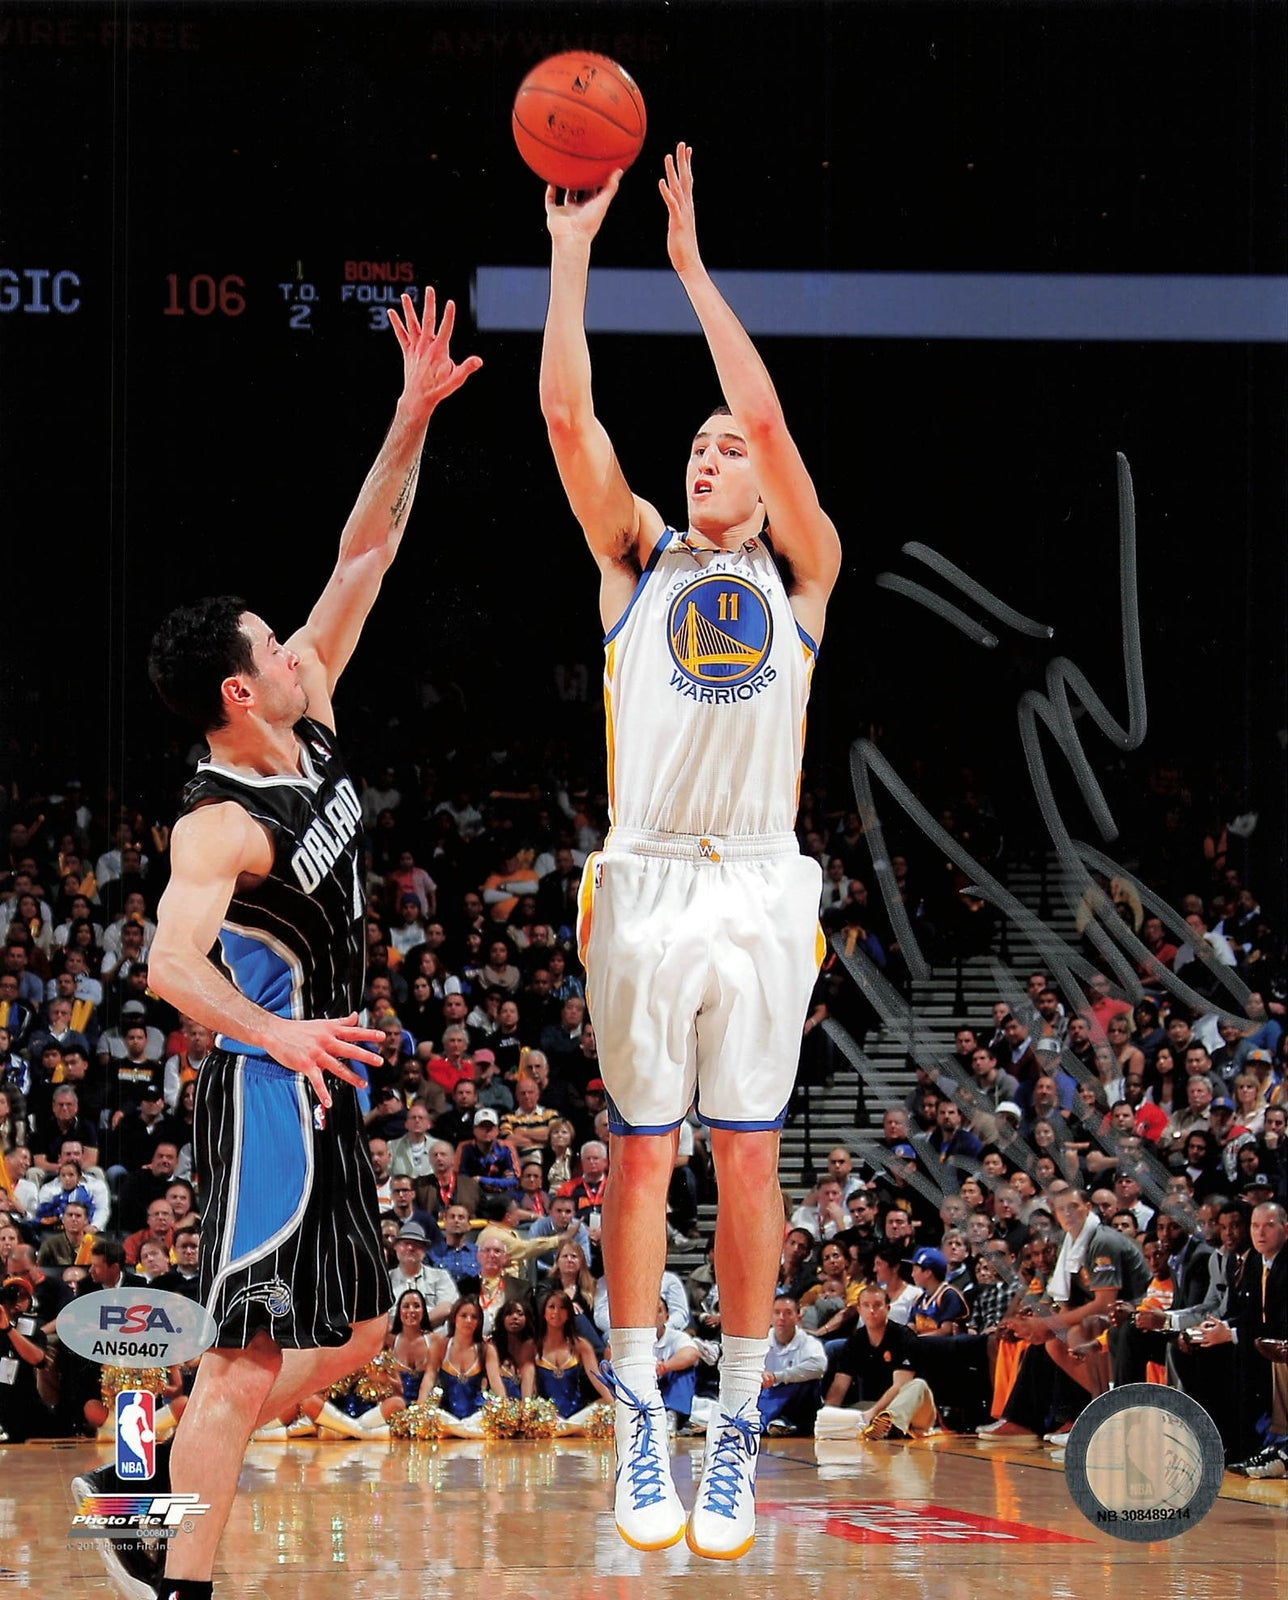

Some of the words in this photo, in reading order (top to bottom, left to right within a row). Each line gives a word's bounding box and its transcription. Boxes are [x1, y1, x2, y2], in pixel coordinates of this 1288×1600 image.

[344, 260, 415, 283] BONUS
[0, 268, 80, 314] GIC
[163, 273, 246, 316] 106
[278, 283, 320, 301] T.O.
[289, 304, 312, 329] 2
[368, 305, 389, 331] 3
[716, 592, 740, 621] 11
[667, 665, 777, 705] WARRIORS
